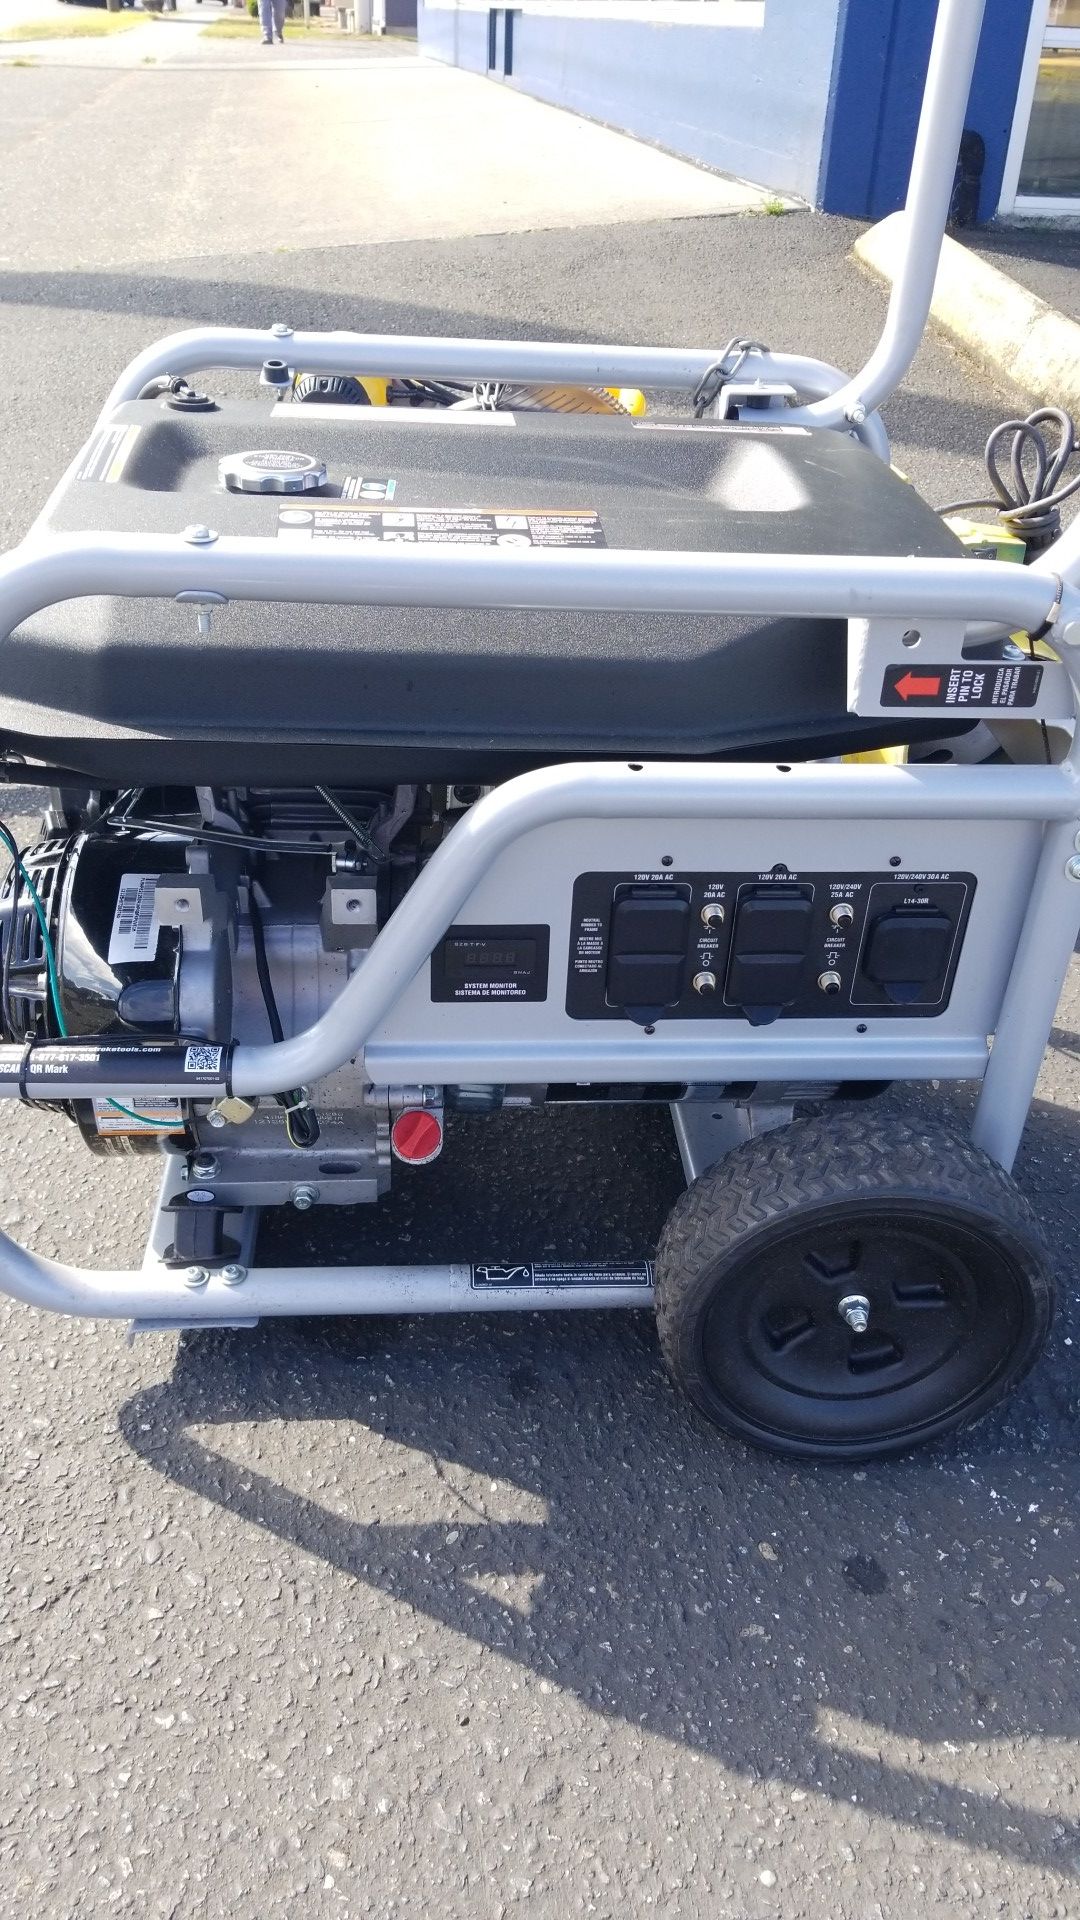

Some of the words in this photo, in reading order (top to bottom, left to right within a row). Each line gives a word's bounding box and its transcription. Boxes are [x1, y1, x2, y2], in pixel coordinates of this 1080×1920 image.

[945, 668, 961, 703] INSERT
[961, 670, 974, 684] TO
[971, 673, 986, 699] LOCK
[991, 667, 1005, 705] INTRODUZCA
[1001, 668, 1014, 696] PASADOR
[1010, 666, 1022, 690] TRABAR
[958, 685, 971, 702] PIN
[1007, 690, 1016, 706] PARA
[30, 1063, 45, 1074] QR
[45, 1064, 69, 1074] Mark
